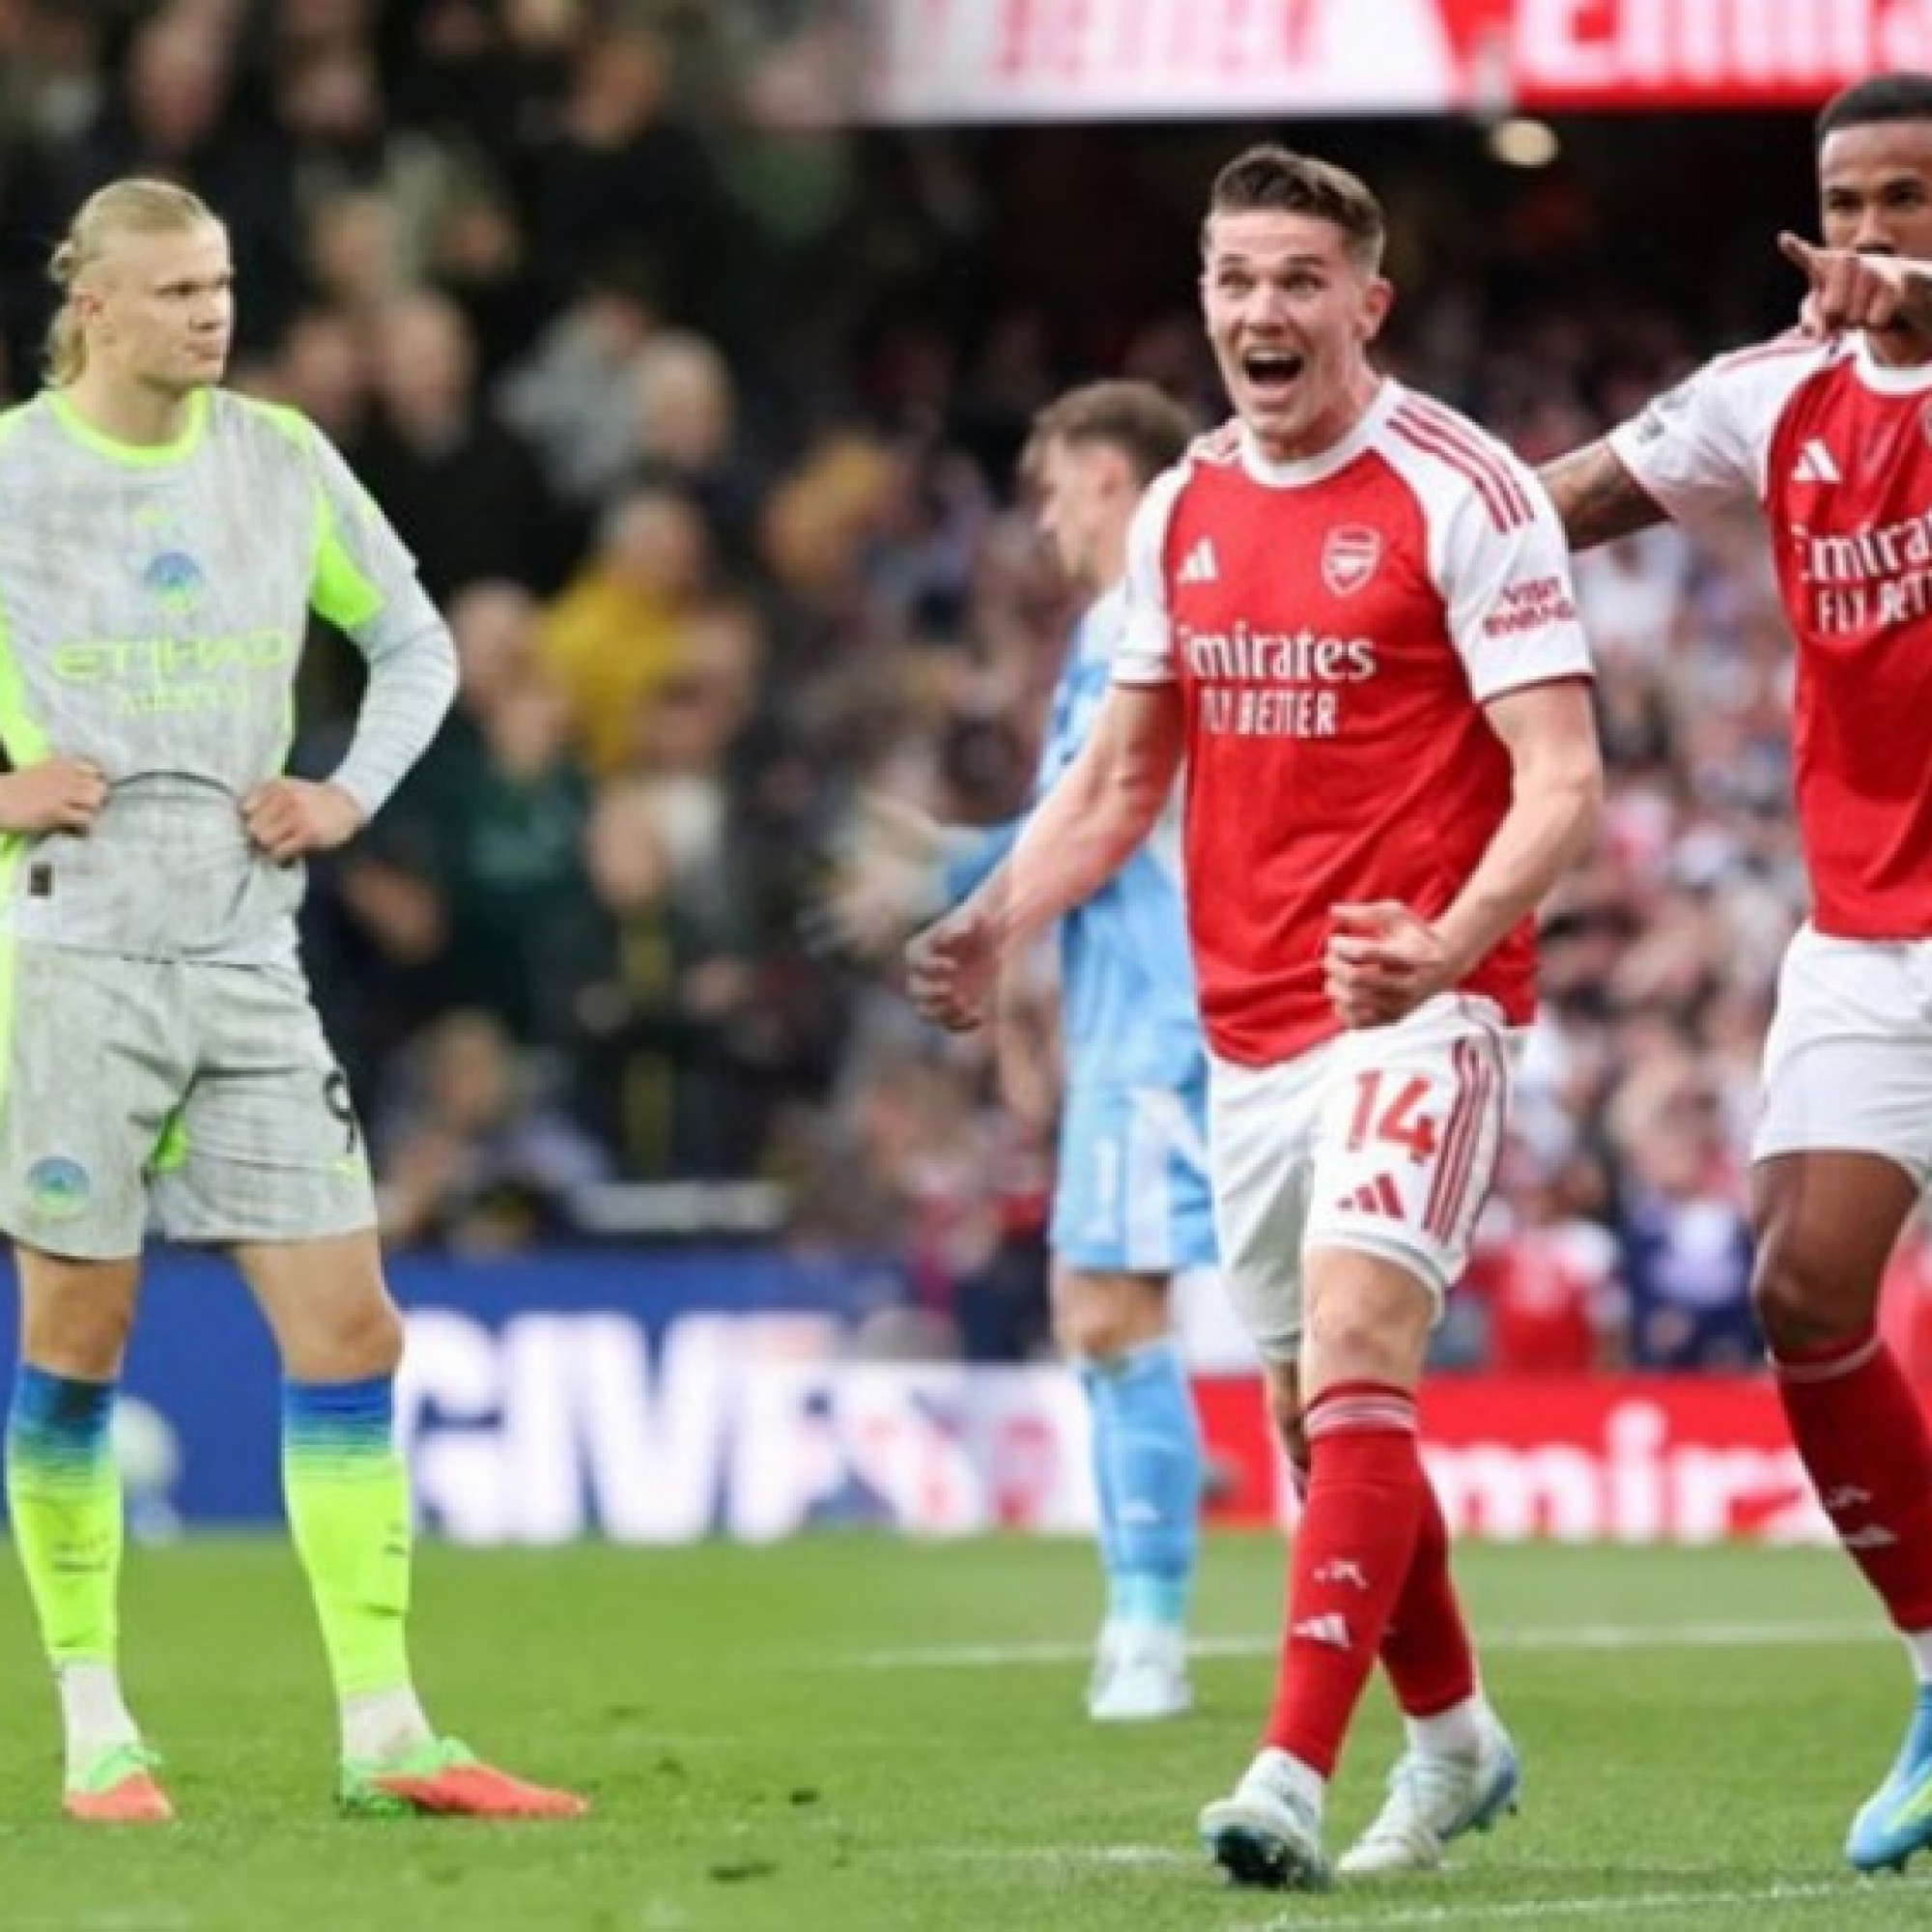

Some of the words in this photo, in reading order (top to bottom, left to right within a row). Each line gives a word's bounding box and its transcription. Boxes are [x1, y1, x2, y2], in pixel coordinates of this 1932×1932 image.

[1178, 616, 1378, 682] mirates
[1349, 1068, 1437, 1164] 14
[1270, 1399, 1840, 1544] mir
